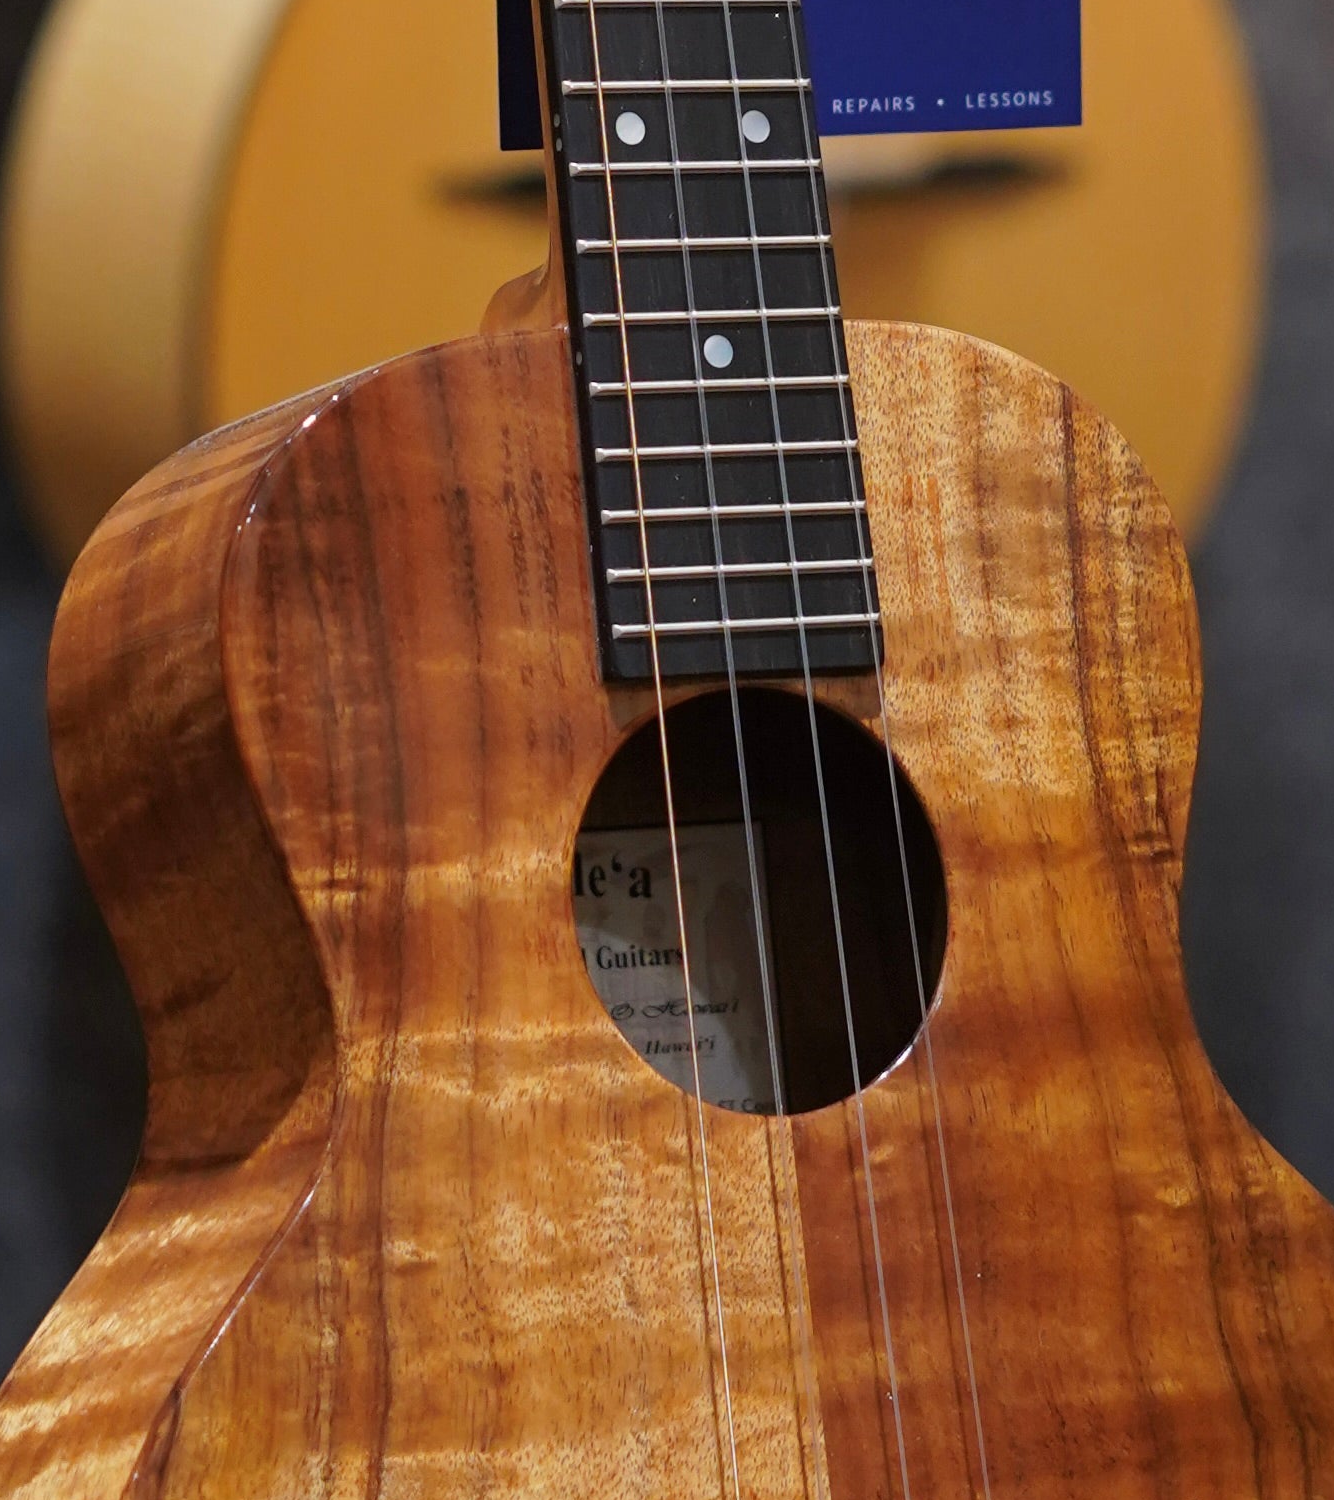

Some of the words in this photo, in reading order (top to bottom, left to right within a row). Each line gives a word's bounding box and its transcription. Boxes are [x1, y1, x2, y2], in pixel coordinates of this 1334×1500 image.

[832, 96, 916, 114] REPAIRS
[965, 90, 1053, 109] LESSONS
[596, 944, 684, 971] Guitars
